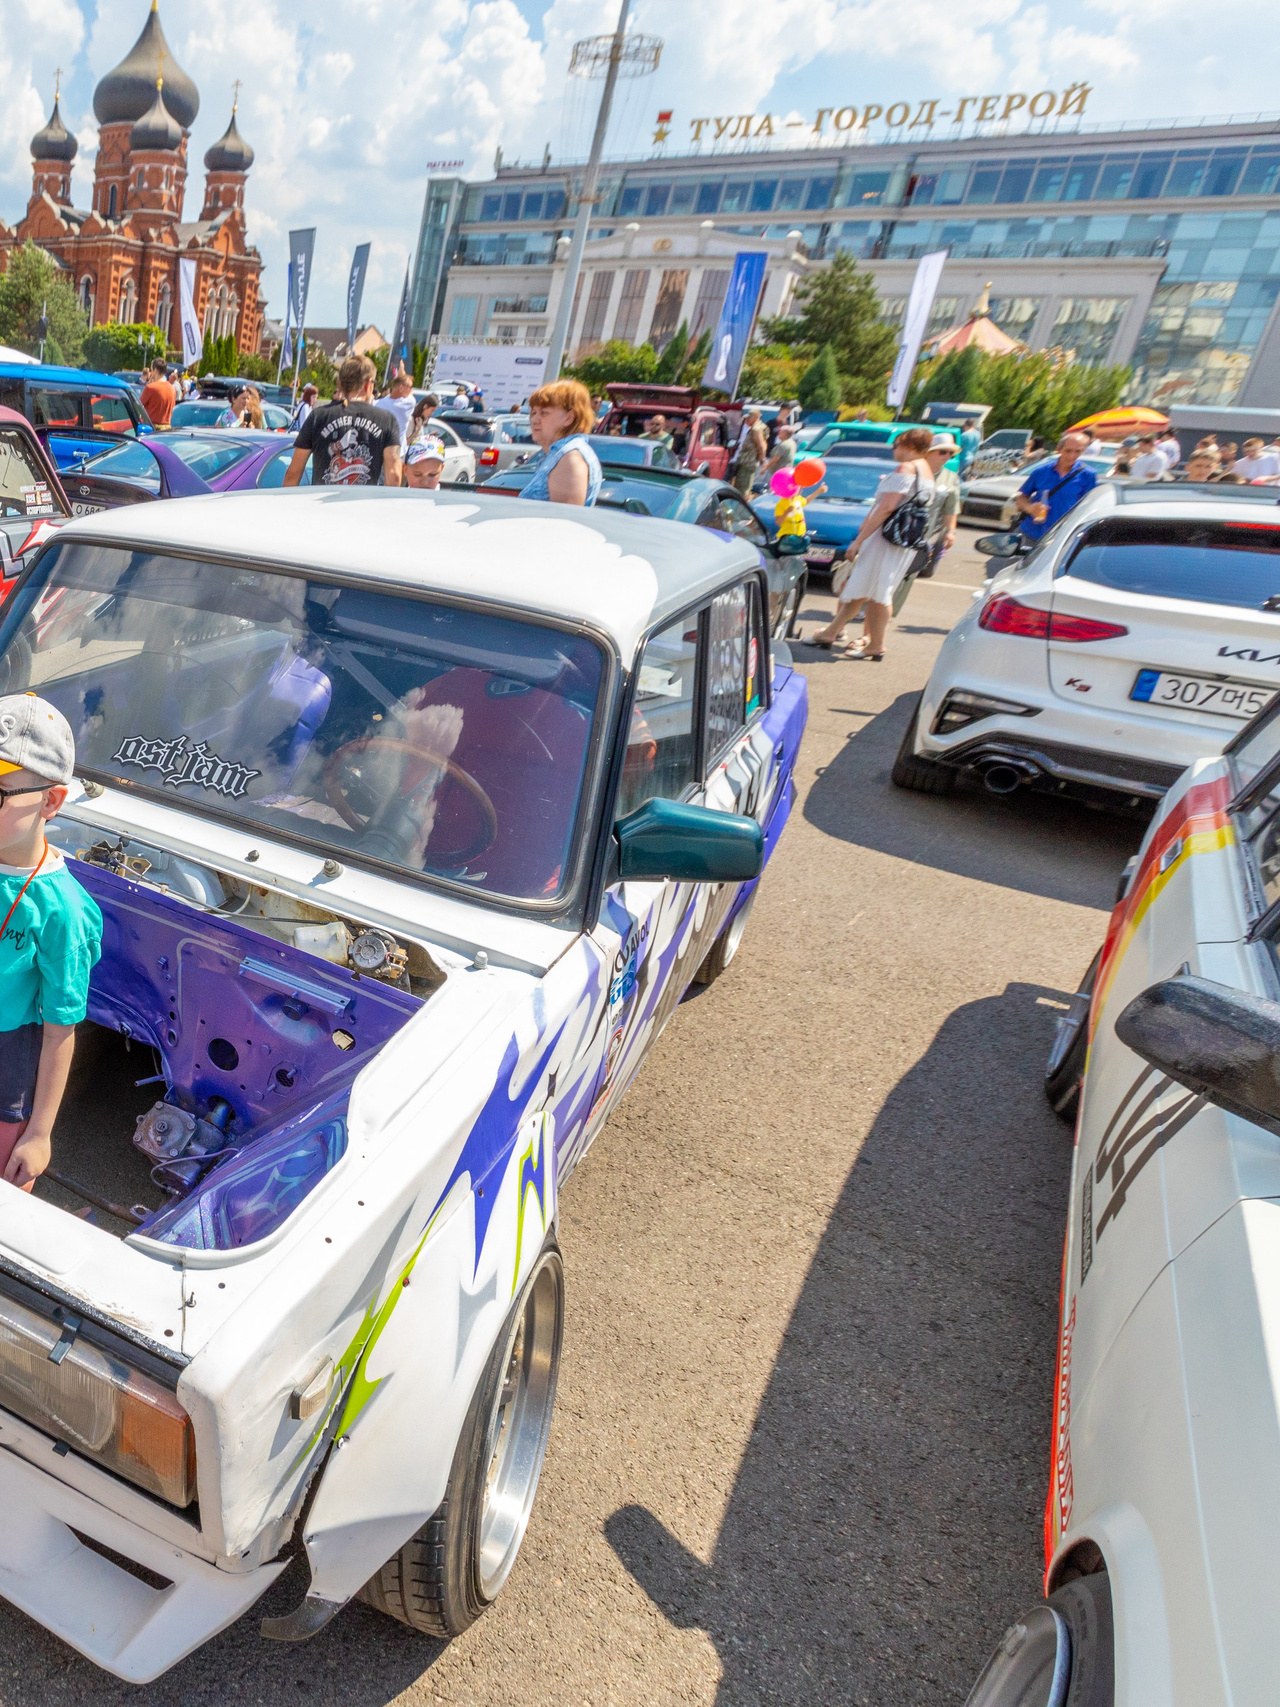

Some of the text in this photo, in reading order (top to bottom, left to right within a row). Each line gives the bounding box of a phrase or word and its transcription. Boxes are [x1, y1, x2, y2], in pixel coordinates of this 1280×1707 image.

[690, 112, 774, 141] ТУЛА
[811, 81, 1094, 133] ГОРОД-ГЕРОЙ
[449, 355, 482, 363] EVOLUTE
[321, 415, 382, 438] MOTHER RUSSIA
